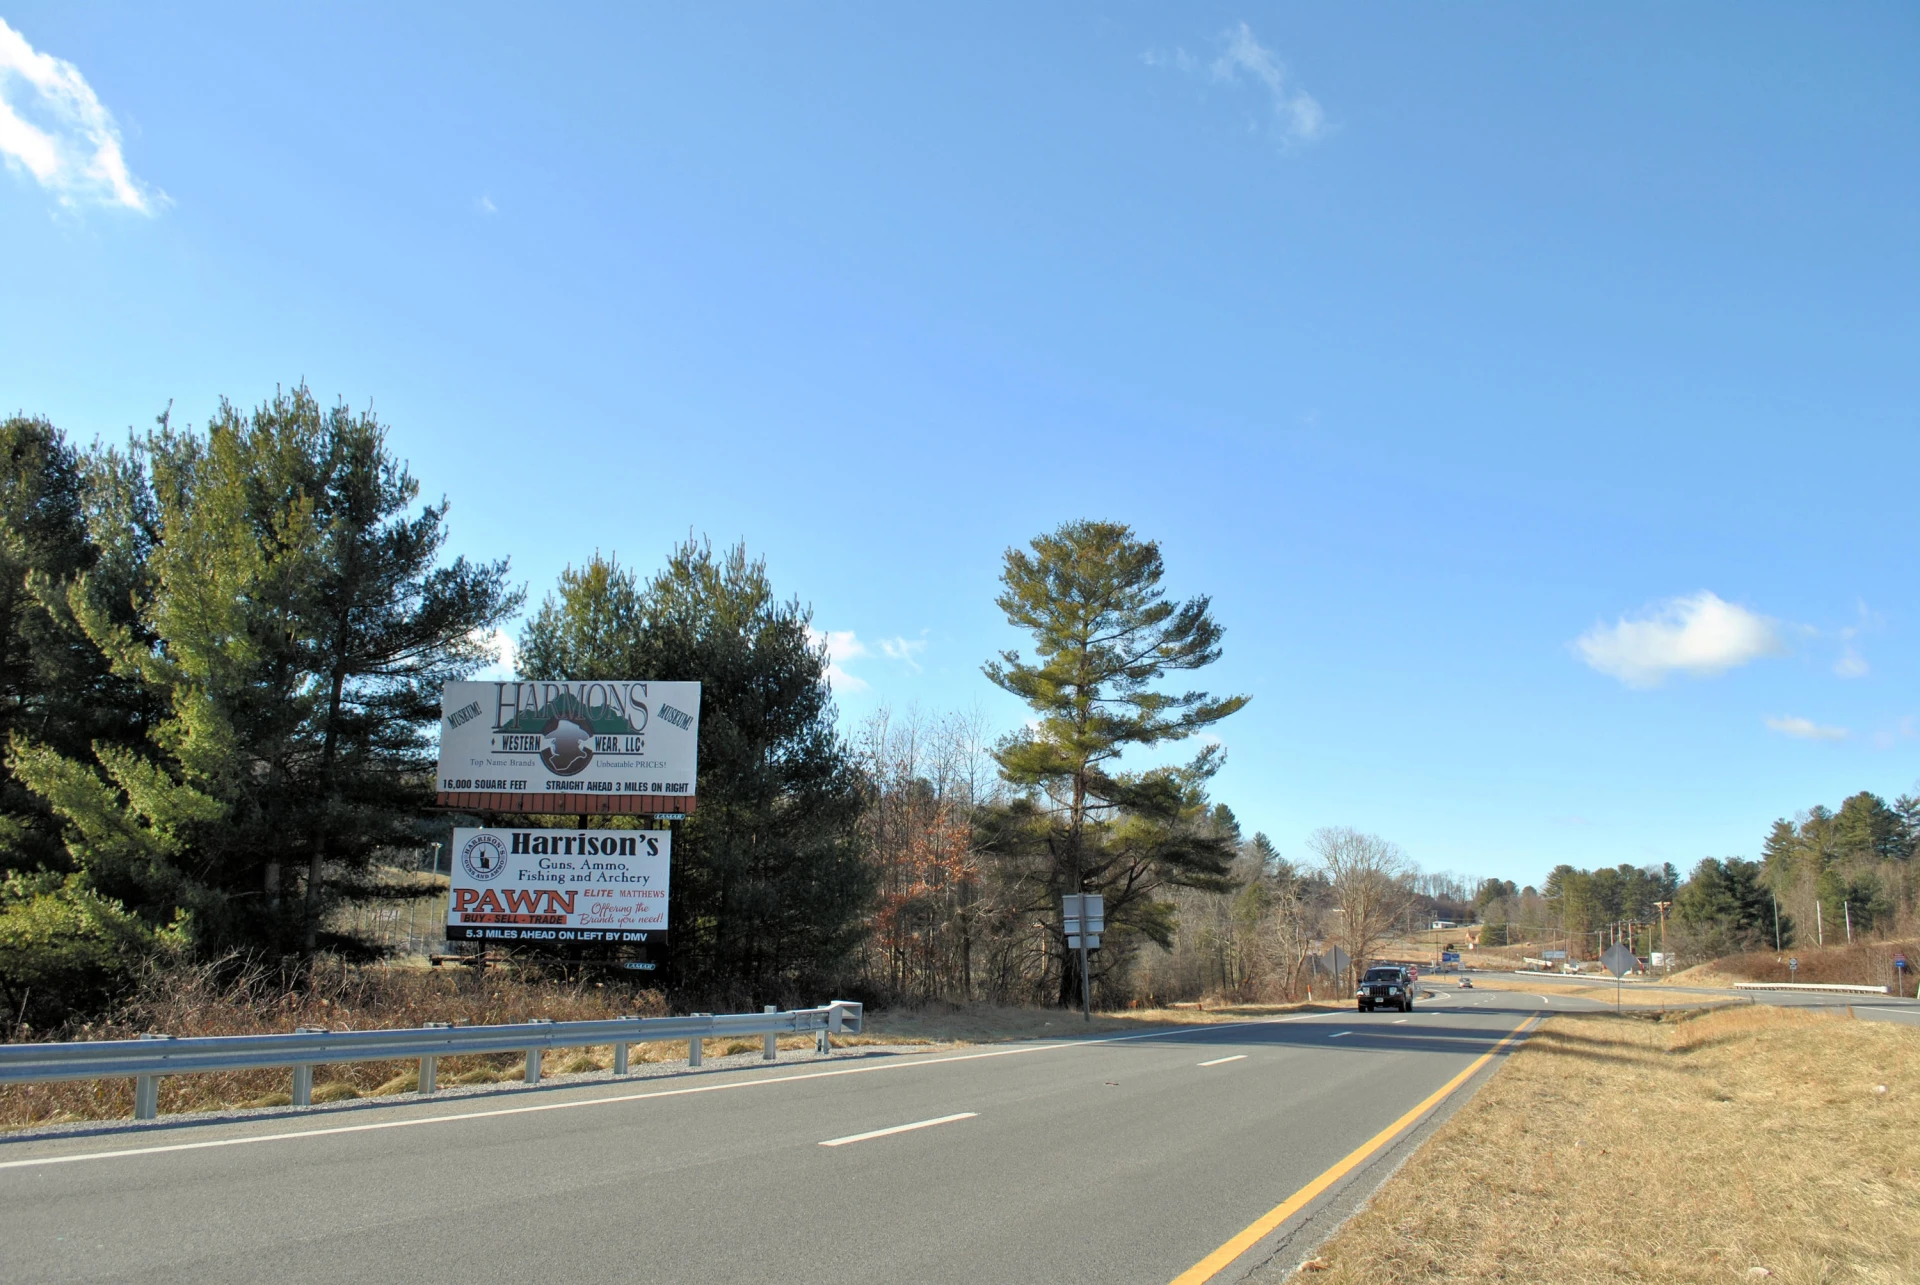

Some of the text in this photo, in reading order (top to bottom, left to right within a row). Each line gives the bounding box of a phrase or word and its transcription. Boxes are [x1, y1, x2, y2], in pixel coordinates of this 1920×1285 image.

[492, 683, 648, 732] HARMONS
[447, 701, 482, 730] MUSEUM!
[658, 703, 694, 731] MUSEUM!
[502, 735, 641, 753] WESTERN WEAR, LLC
[470, 758, 484, 767] Top
[510, 759, 535, 767] Brands
[596, 760, 633, 768] Unbeatable
[443, 779, 527, 790] 16,000 SQUARE FEET
[546, 780, 689, 793] STRAIGHT AHEAD 3 MILES ON RIGHT
[511, 833, 659, 856] Harrison's
[518, 870, 650, 886] Fishing and Archery
[453, 888, 578, 914] PAWN
[592, 902, 650, 917] Offering the
[464, 914, 485, 923] BUY
[494, 914, 519, 923] SELL
[529, 915, 564, 924] TRADE
[578, 913, 664, 928] Brands you need!
[485, 930, 517, 938] MILES
[521, 930, 555, 939] AHEAD
[558, 931, 574, 939] ON
[578, 932, 604, 940] LEFT
[606, 932, 620, 941] BY
[622, 933, 647, 941] DMV
